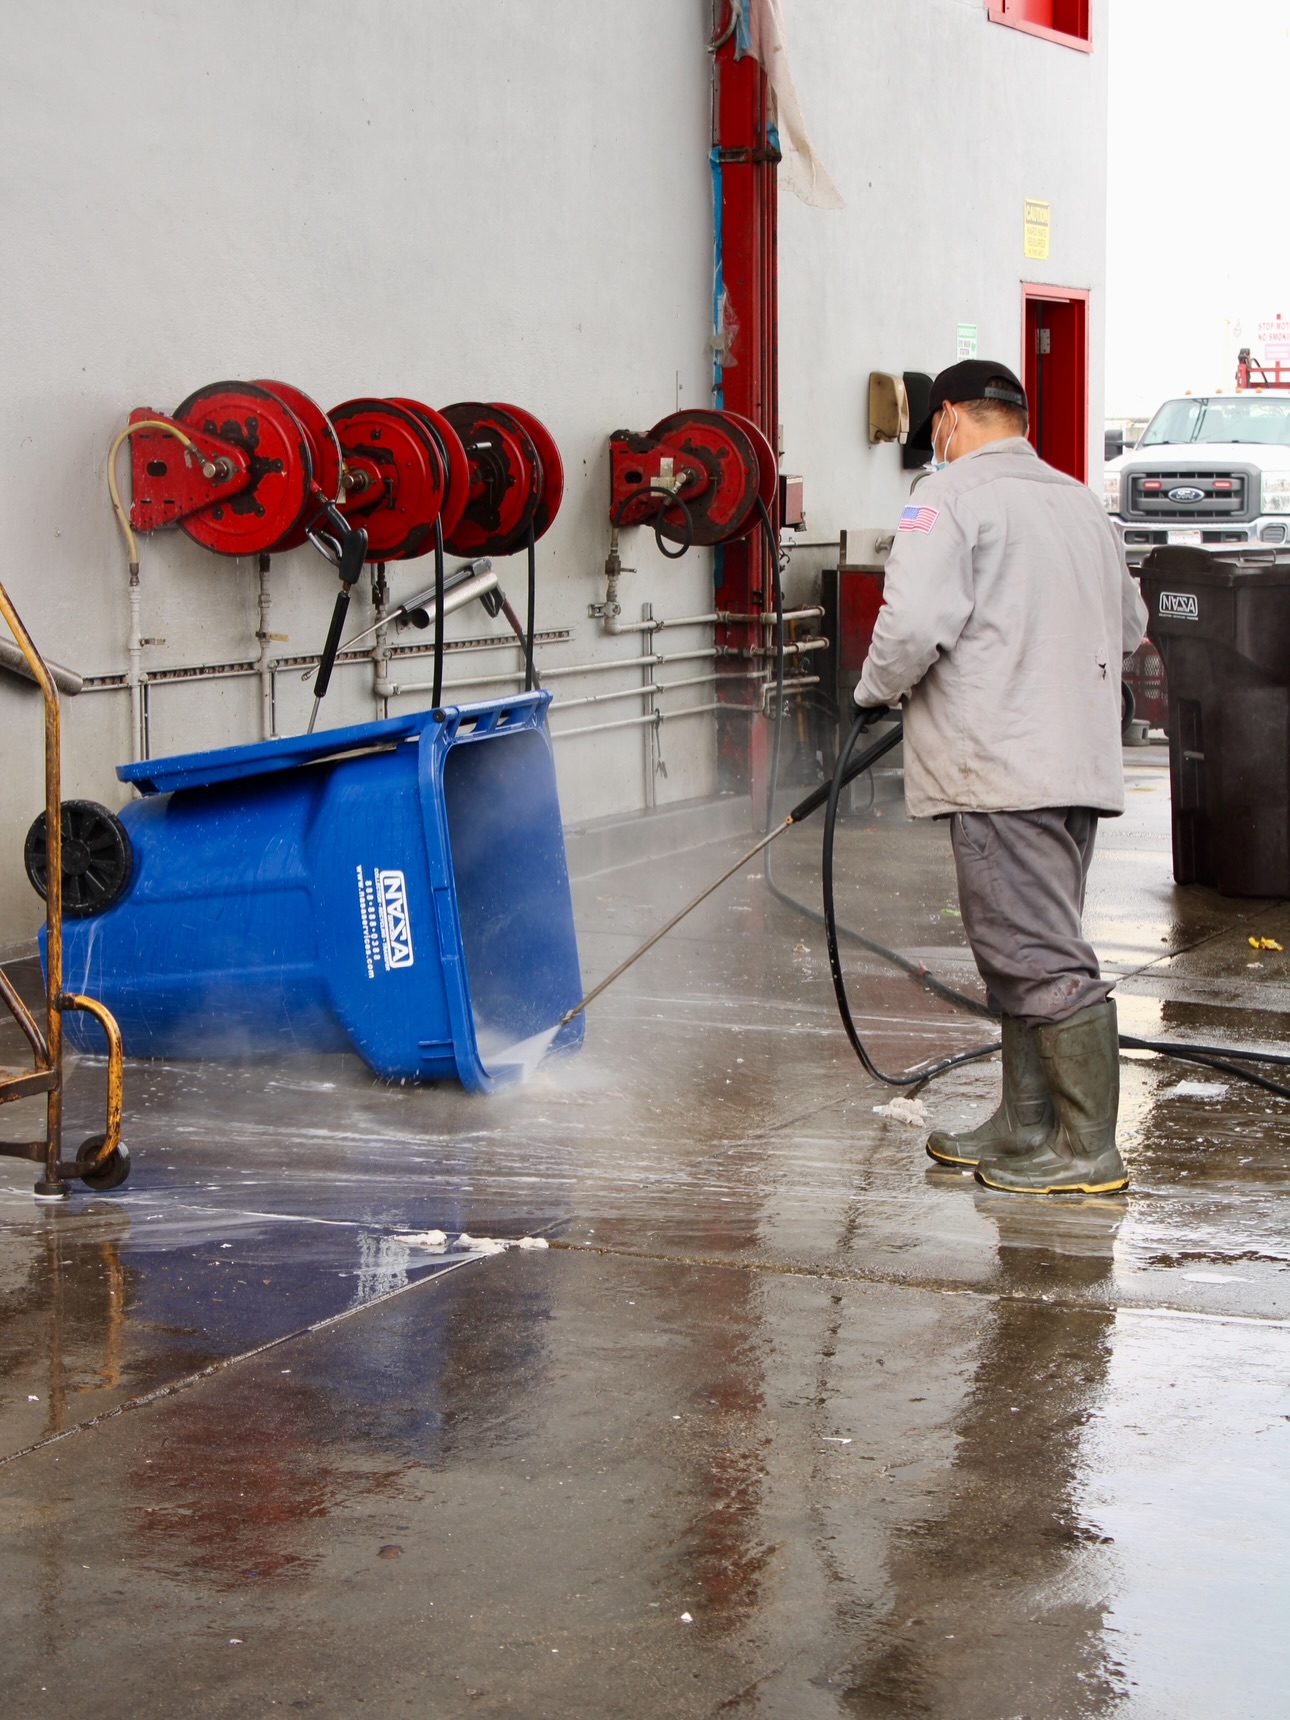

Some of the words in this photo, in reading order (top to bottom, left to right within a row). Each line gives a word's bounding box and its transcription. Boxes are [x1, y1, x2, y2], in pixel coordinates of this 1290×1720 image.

[1258, 322, 1274, 330] STOP
[1276, 322, 1290, 330] MOT
[1258, 333, 1267, 341] NO
[356, 864, 375, 979] www.nasaservices.com
